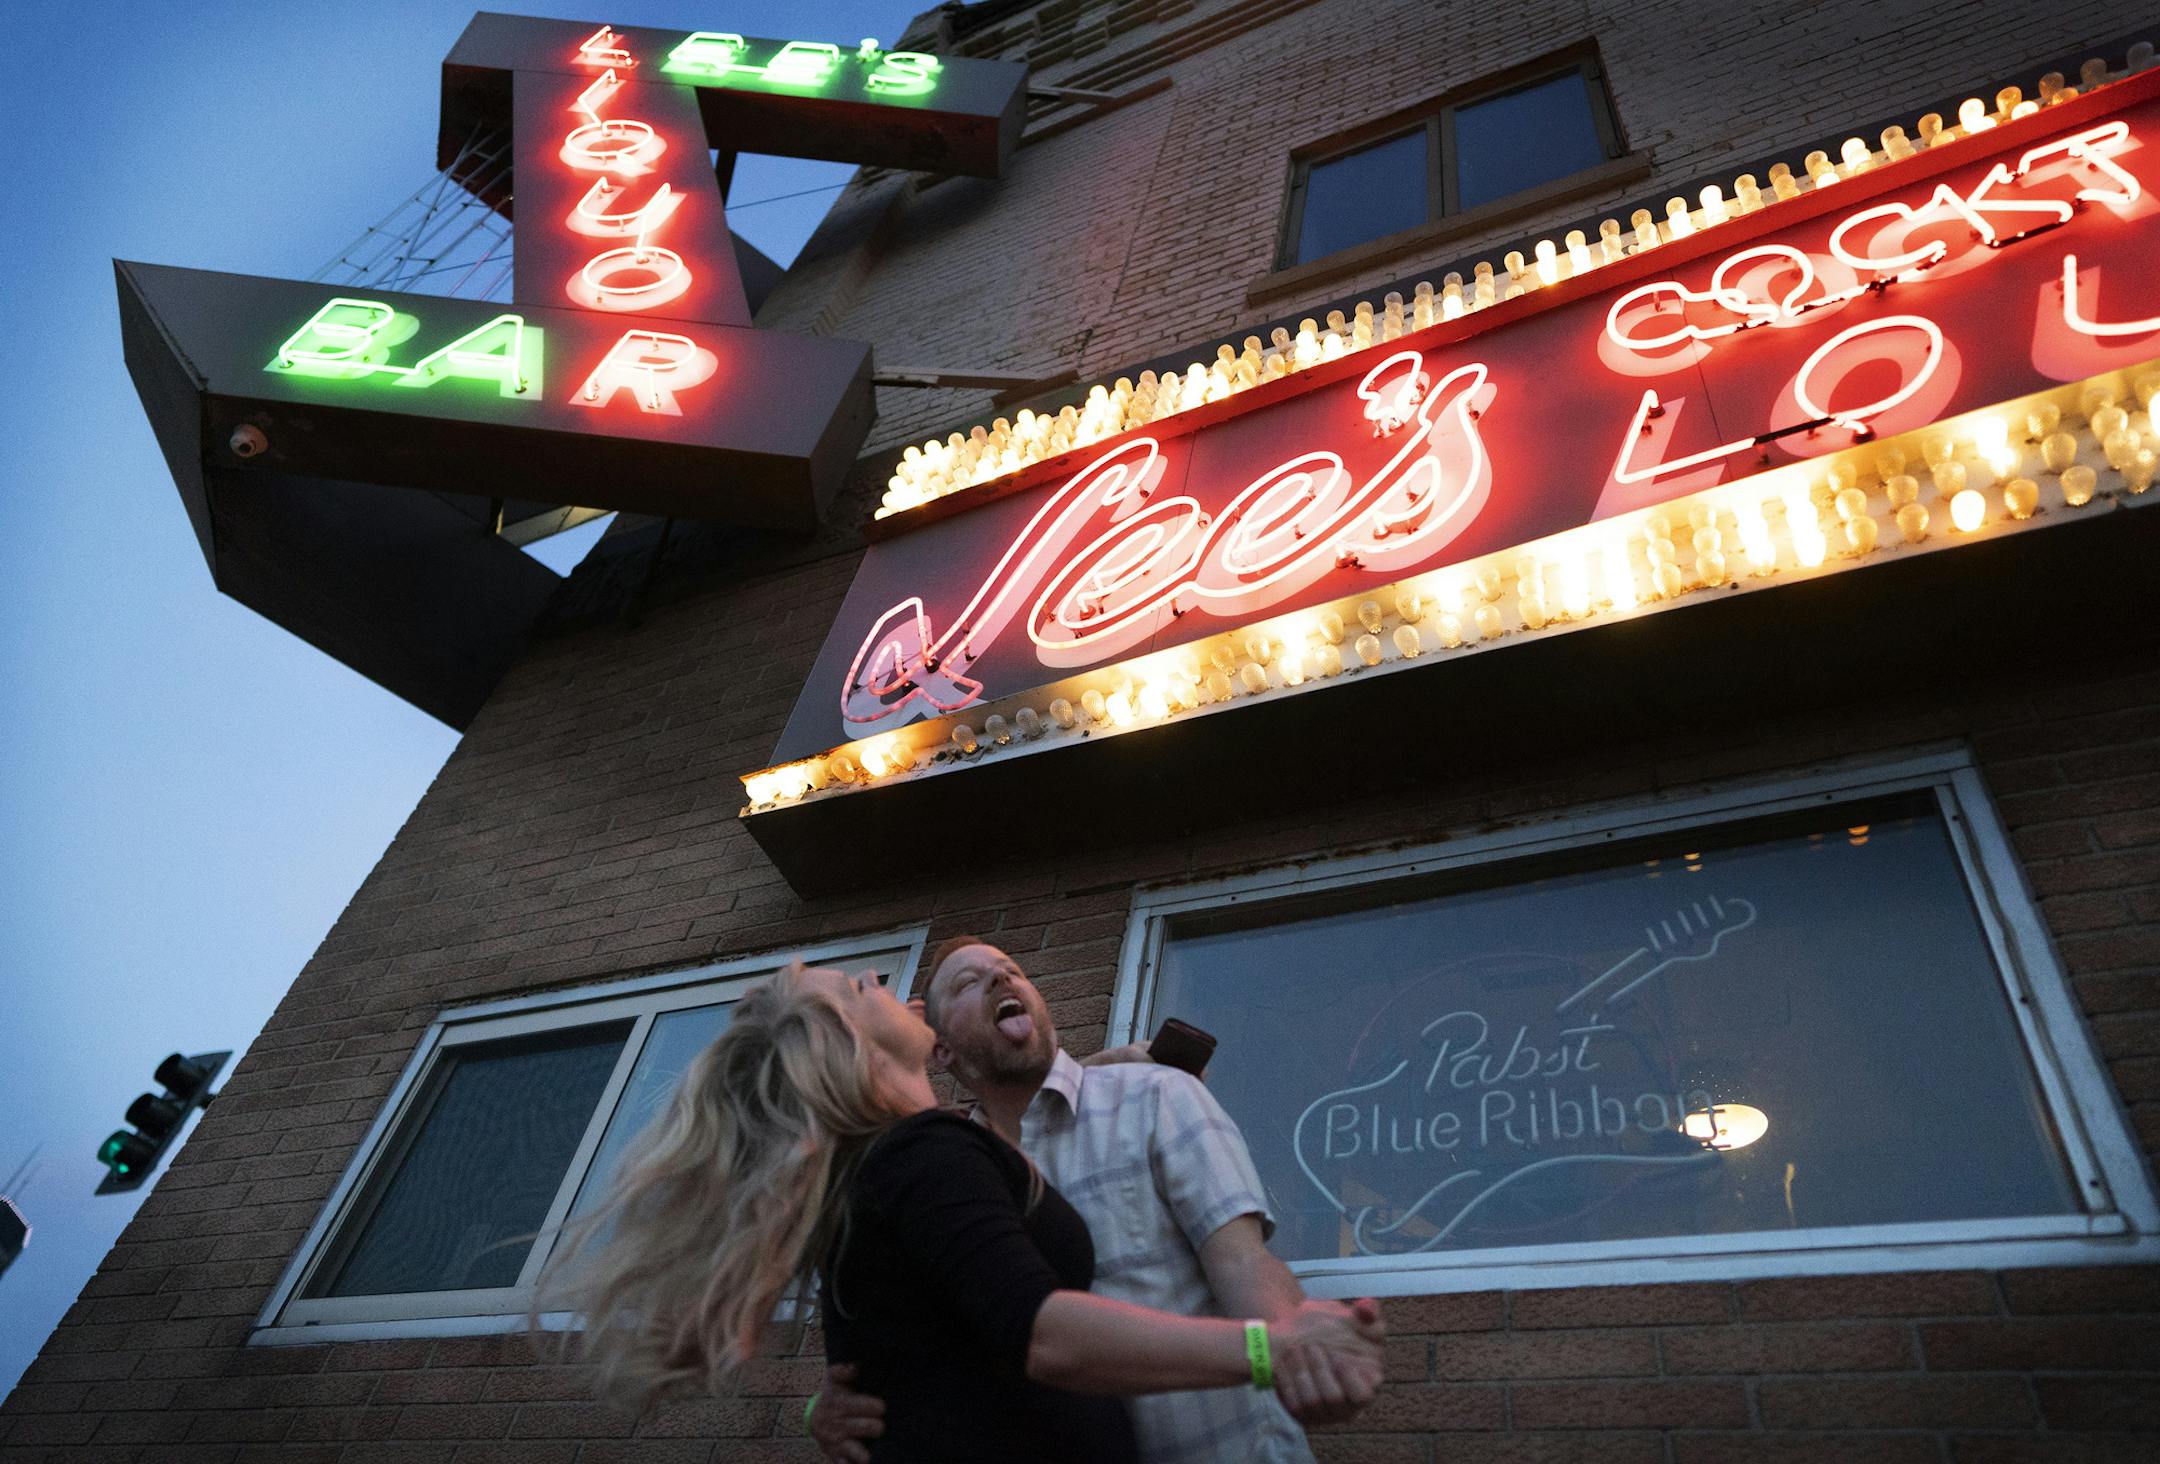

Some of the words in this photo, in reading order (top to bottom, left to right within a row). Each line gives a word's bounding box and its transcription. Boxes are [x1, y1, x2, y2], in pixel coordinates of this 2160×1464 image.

[558, 24, 719, 416] LIQUOR
[263, 297, 719, 416] BAR
[840, 350, 1497, 742] Lee's
[1420, 1010, 1615, 1094] Pabst
[1323, 1101, 1462, 1159] Blue
[1480, 1084, 1718, 1148] Ribbon
